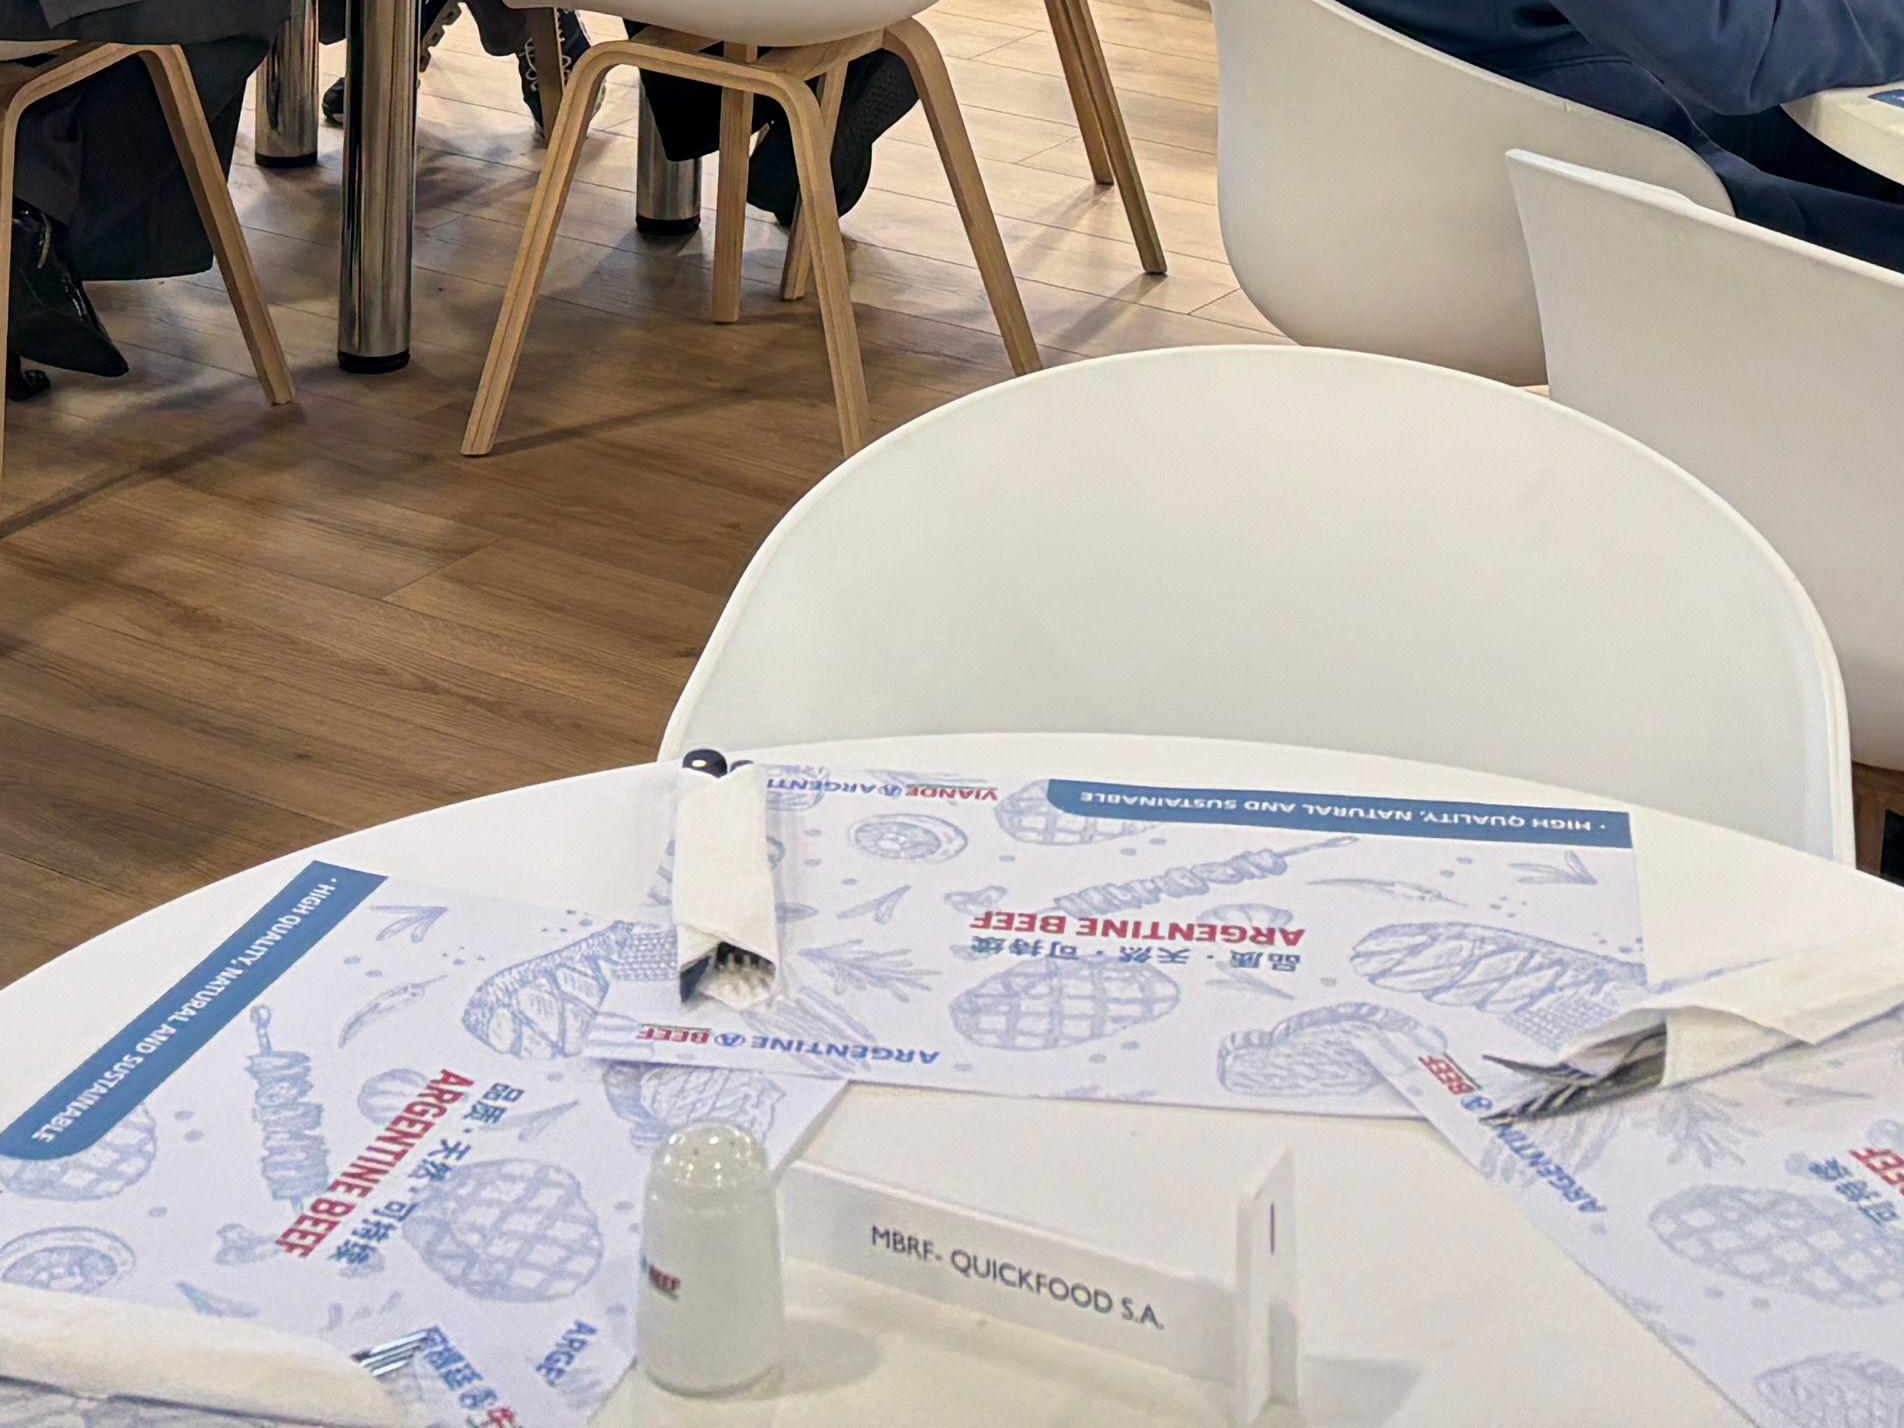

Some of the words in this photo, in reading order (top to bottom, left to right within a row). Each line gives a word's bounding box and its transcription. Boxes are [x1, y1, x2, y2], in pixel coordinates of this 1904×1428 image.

[767, 777, 877, 795] ARGENTI
[905, 784, 998, 801] VIANDE
[1080, 790, 1238, 811] SUSTAINABLE
[1243, 801, 1296, 813] AND
[1301, 803, 1412, 822] NATURAL
[1419, 809, 1526, 827] QUALITY,
[1532, 819, 1591, 832] HIGH
[299, 883, 337, 915] HIGH
[969, 909, 1067, 935] BEEF
[1076, 916, 1307, 947] ARGENTINE
[231, 914, 302, 967] QUALITY,
[167, 966, 244, 1024] NATURAL
[135, 1022, 177, 1054] AND
[636, 1026, 711, 1044] BEEF
[751, 1035, 940, 1065] ARGENTINE
[1418, 1055, 1476, 1095] BEEF
[31, 1053, 145, 1144] SUSTAINABLE
[326, 1068, 475, 1198] ARGENTINE
[1496, 1123, 1608, 1213] ARGENTIN
[274, 1197, 357, 1258] BEEF
[871, 1223, 944, 1262] MBRF-
[949, 1249, 1114, 1314] QUICKFOOD
[1121, 1296, 1166, 1331] S.A.
